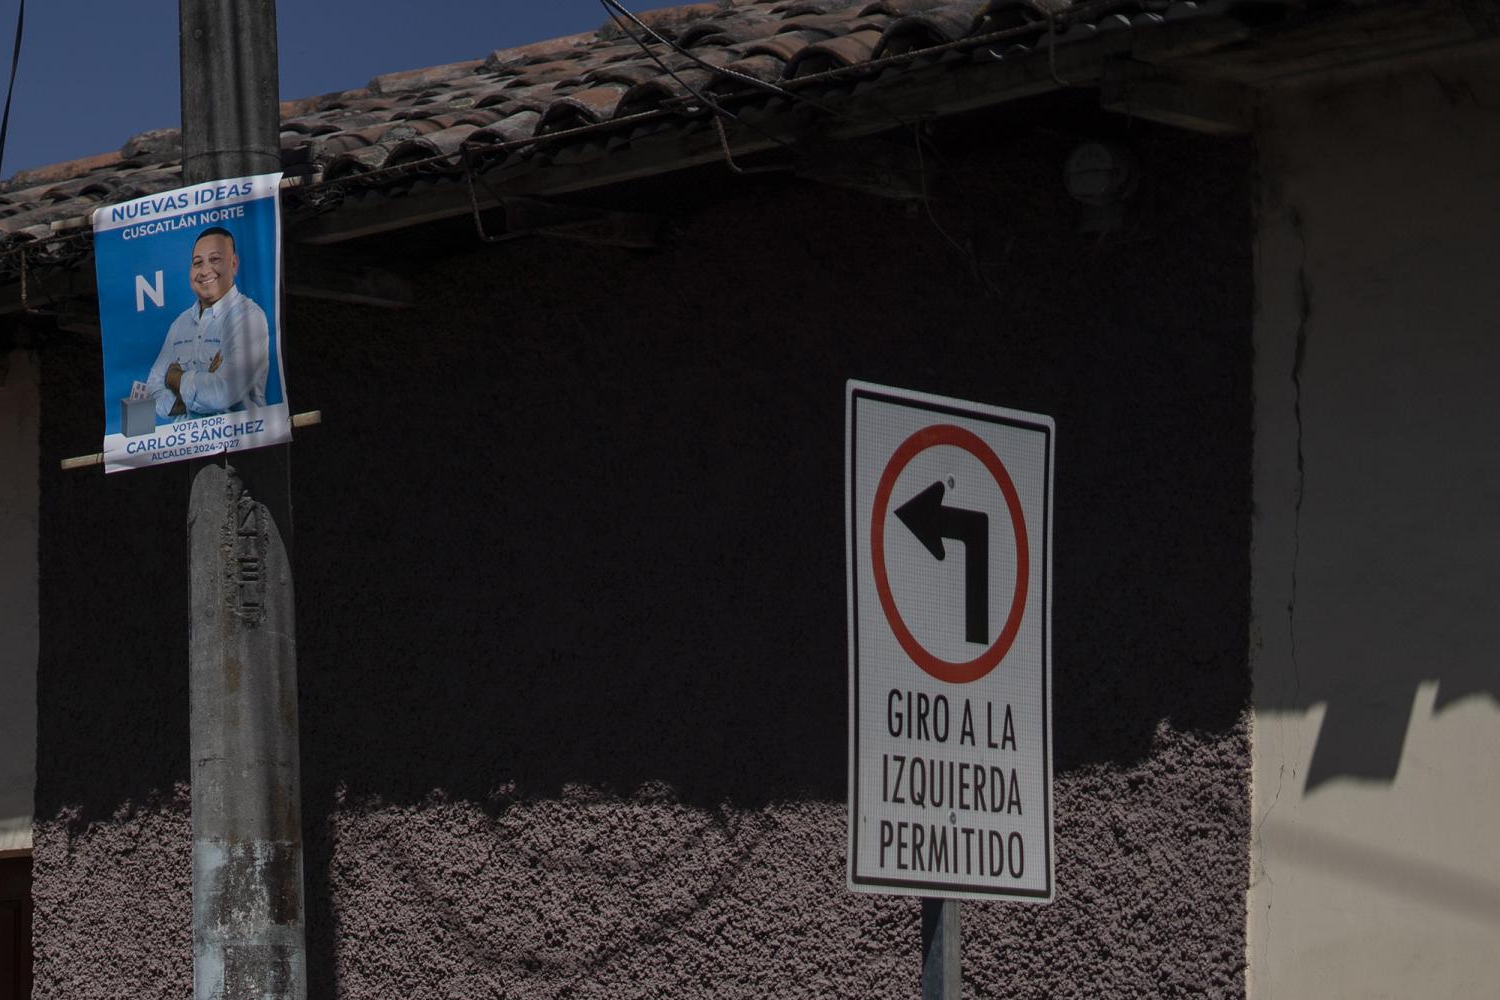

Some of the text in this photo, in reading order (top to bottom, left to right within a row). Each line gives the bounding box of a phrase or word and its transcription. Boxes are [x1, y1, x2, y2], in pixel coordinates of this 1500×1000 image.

[111, 181, 253, 222] NUEVAS IDEAS
[122, 205, 245, 240] CUSCATLÁN NORTE
[135, 270, 165, 312] N
[126, 419, 264, 454] CARLOS SÁNCHEZ
[173, 416, 226, 433] VOTA POR:
[152, 439, 240, 461] ALCALDE 2024-2027
[887, 689, 1018, 752] GIRO A LA
[881, 753, 1023, 816] IZQUIERDA
[879, 819, 1026, 880] PERMITIDO
